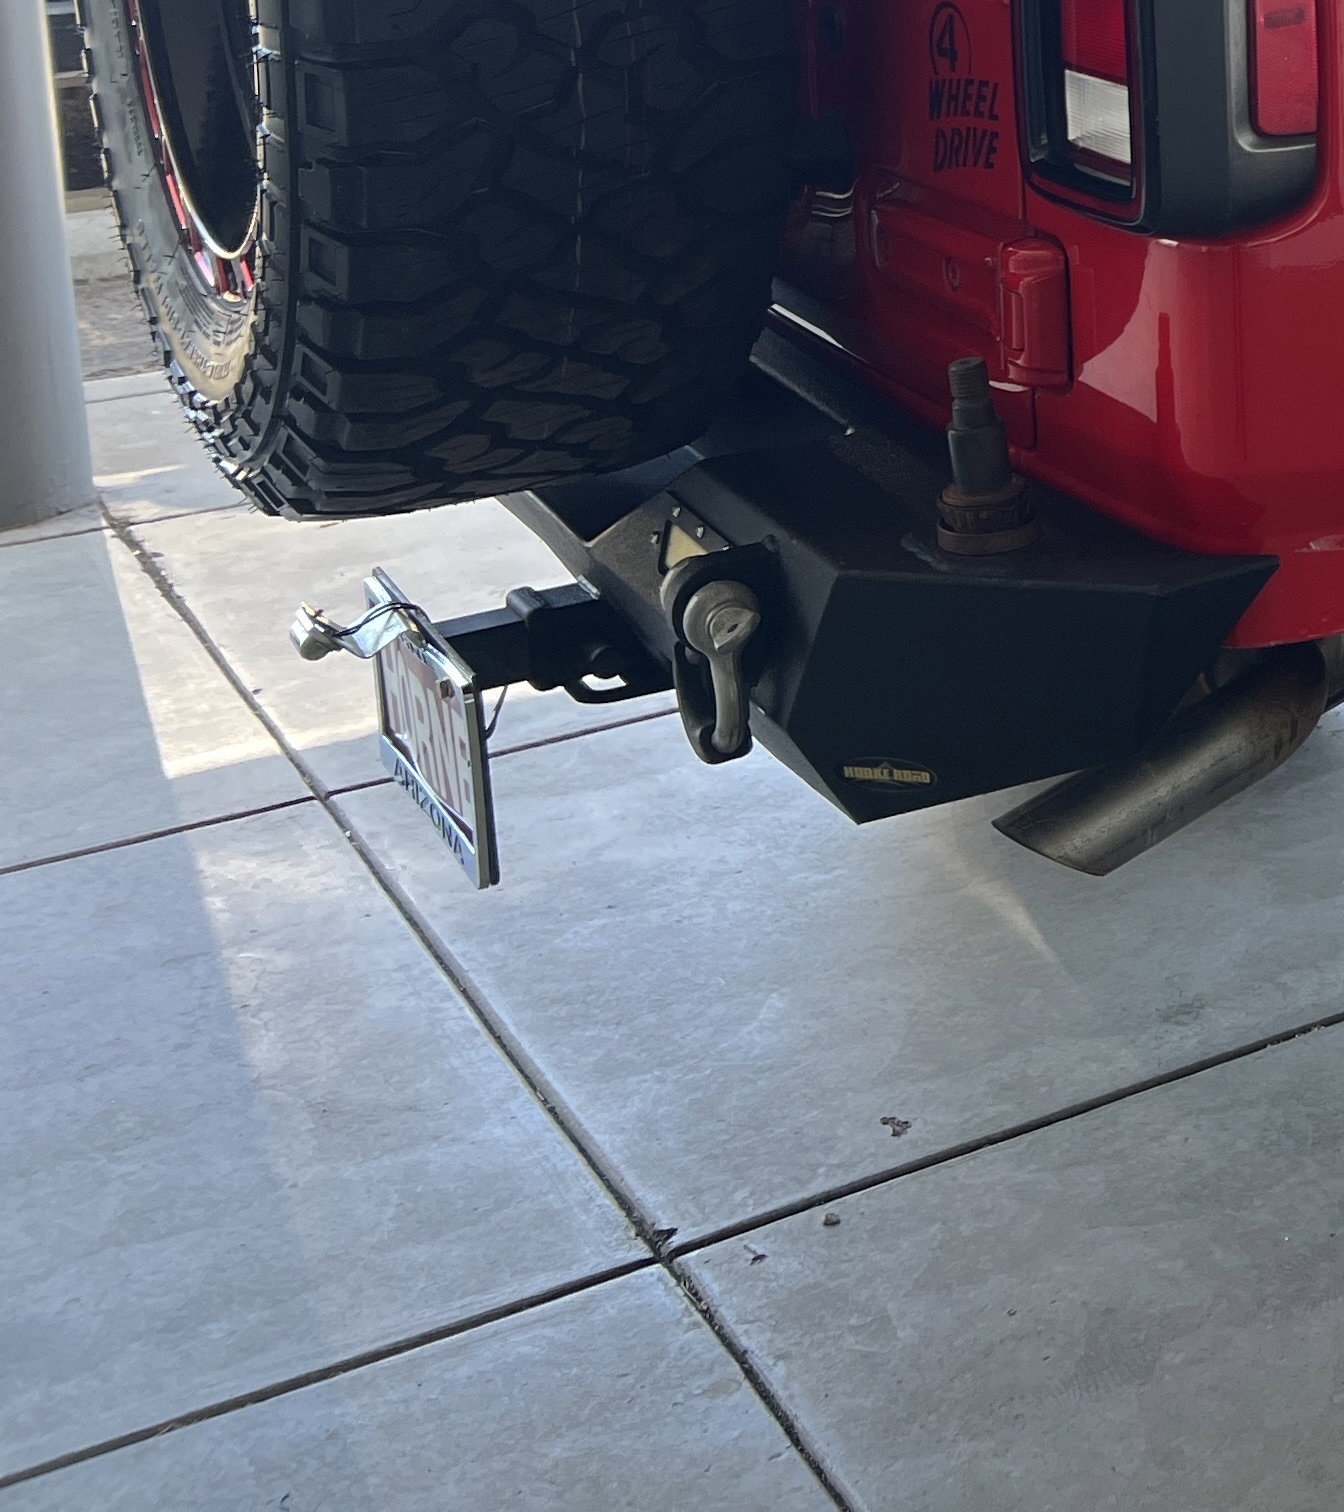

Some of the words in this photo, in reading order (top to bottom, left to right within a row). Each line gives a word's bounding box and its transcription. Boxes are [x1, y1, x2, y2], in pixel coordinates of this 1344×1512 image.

[935, 13, 958, 73] 4
[929, 77, 1000, 122] WHEEL
[933, 125, 1000, 174] DRIVE
[394, 757, 465, 865] ARIZONA
